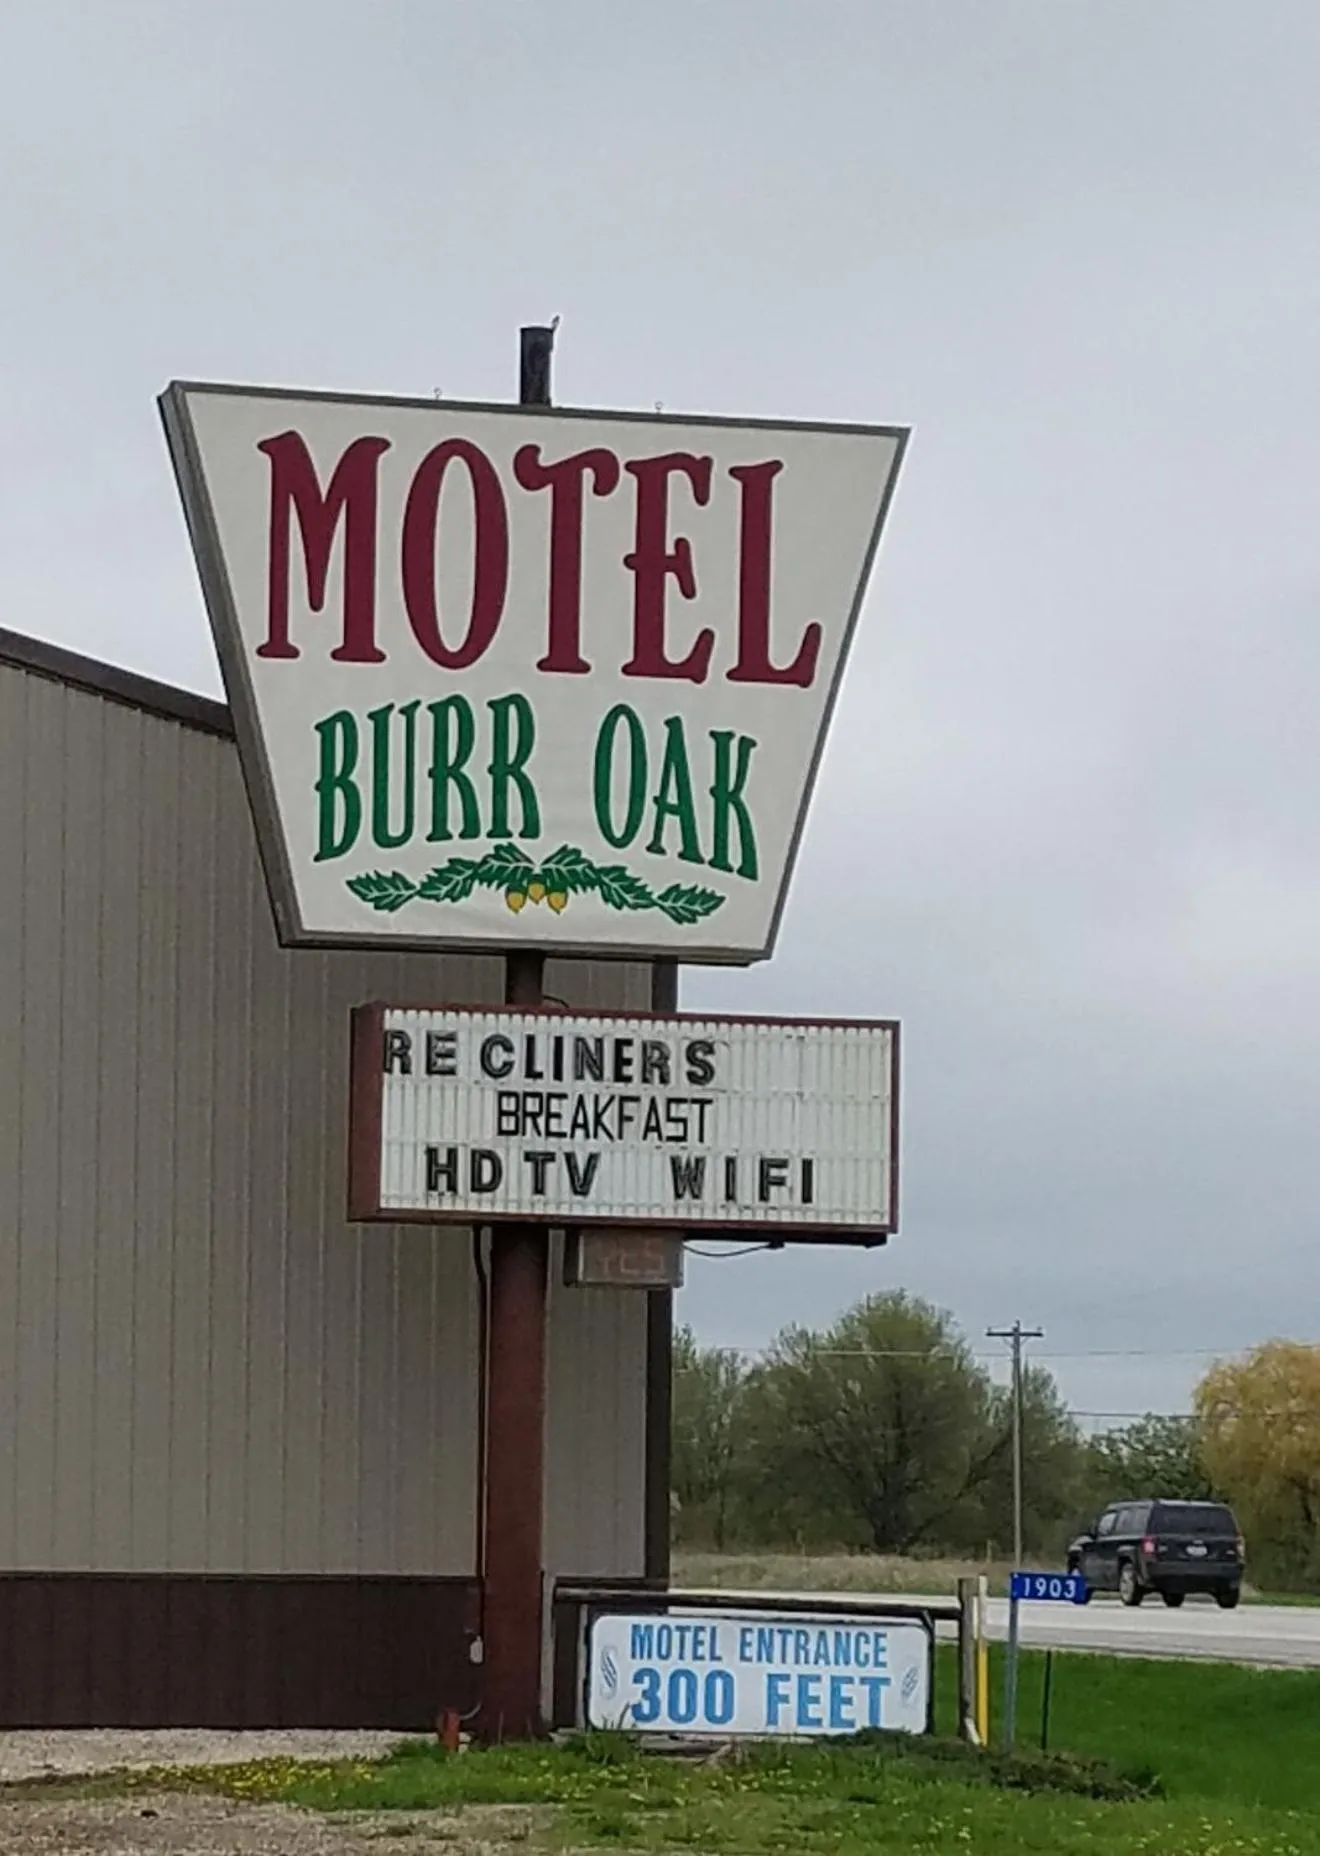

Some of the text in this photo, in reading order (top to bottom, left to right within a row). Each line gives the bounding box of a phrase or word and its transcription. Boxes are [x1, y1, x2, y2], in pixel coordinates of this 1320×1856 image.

[256, 430, 822, 689] MOTEL
[313, 694, 759, 881] BURR OAK
[497, 1091, 713, 1143] BREAKFAST
[670, 1156, 813, 1203] WIFI
[1023, 1577, 1077, 1598] 1903
[631, 1624, 888, 1668] MOTEL ENTRANCE
[631, 1667, 892, 1729] 300 FEET
